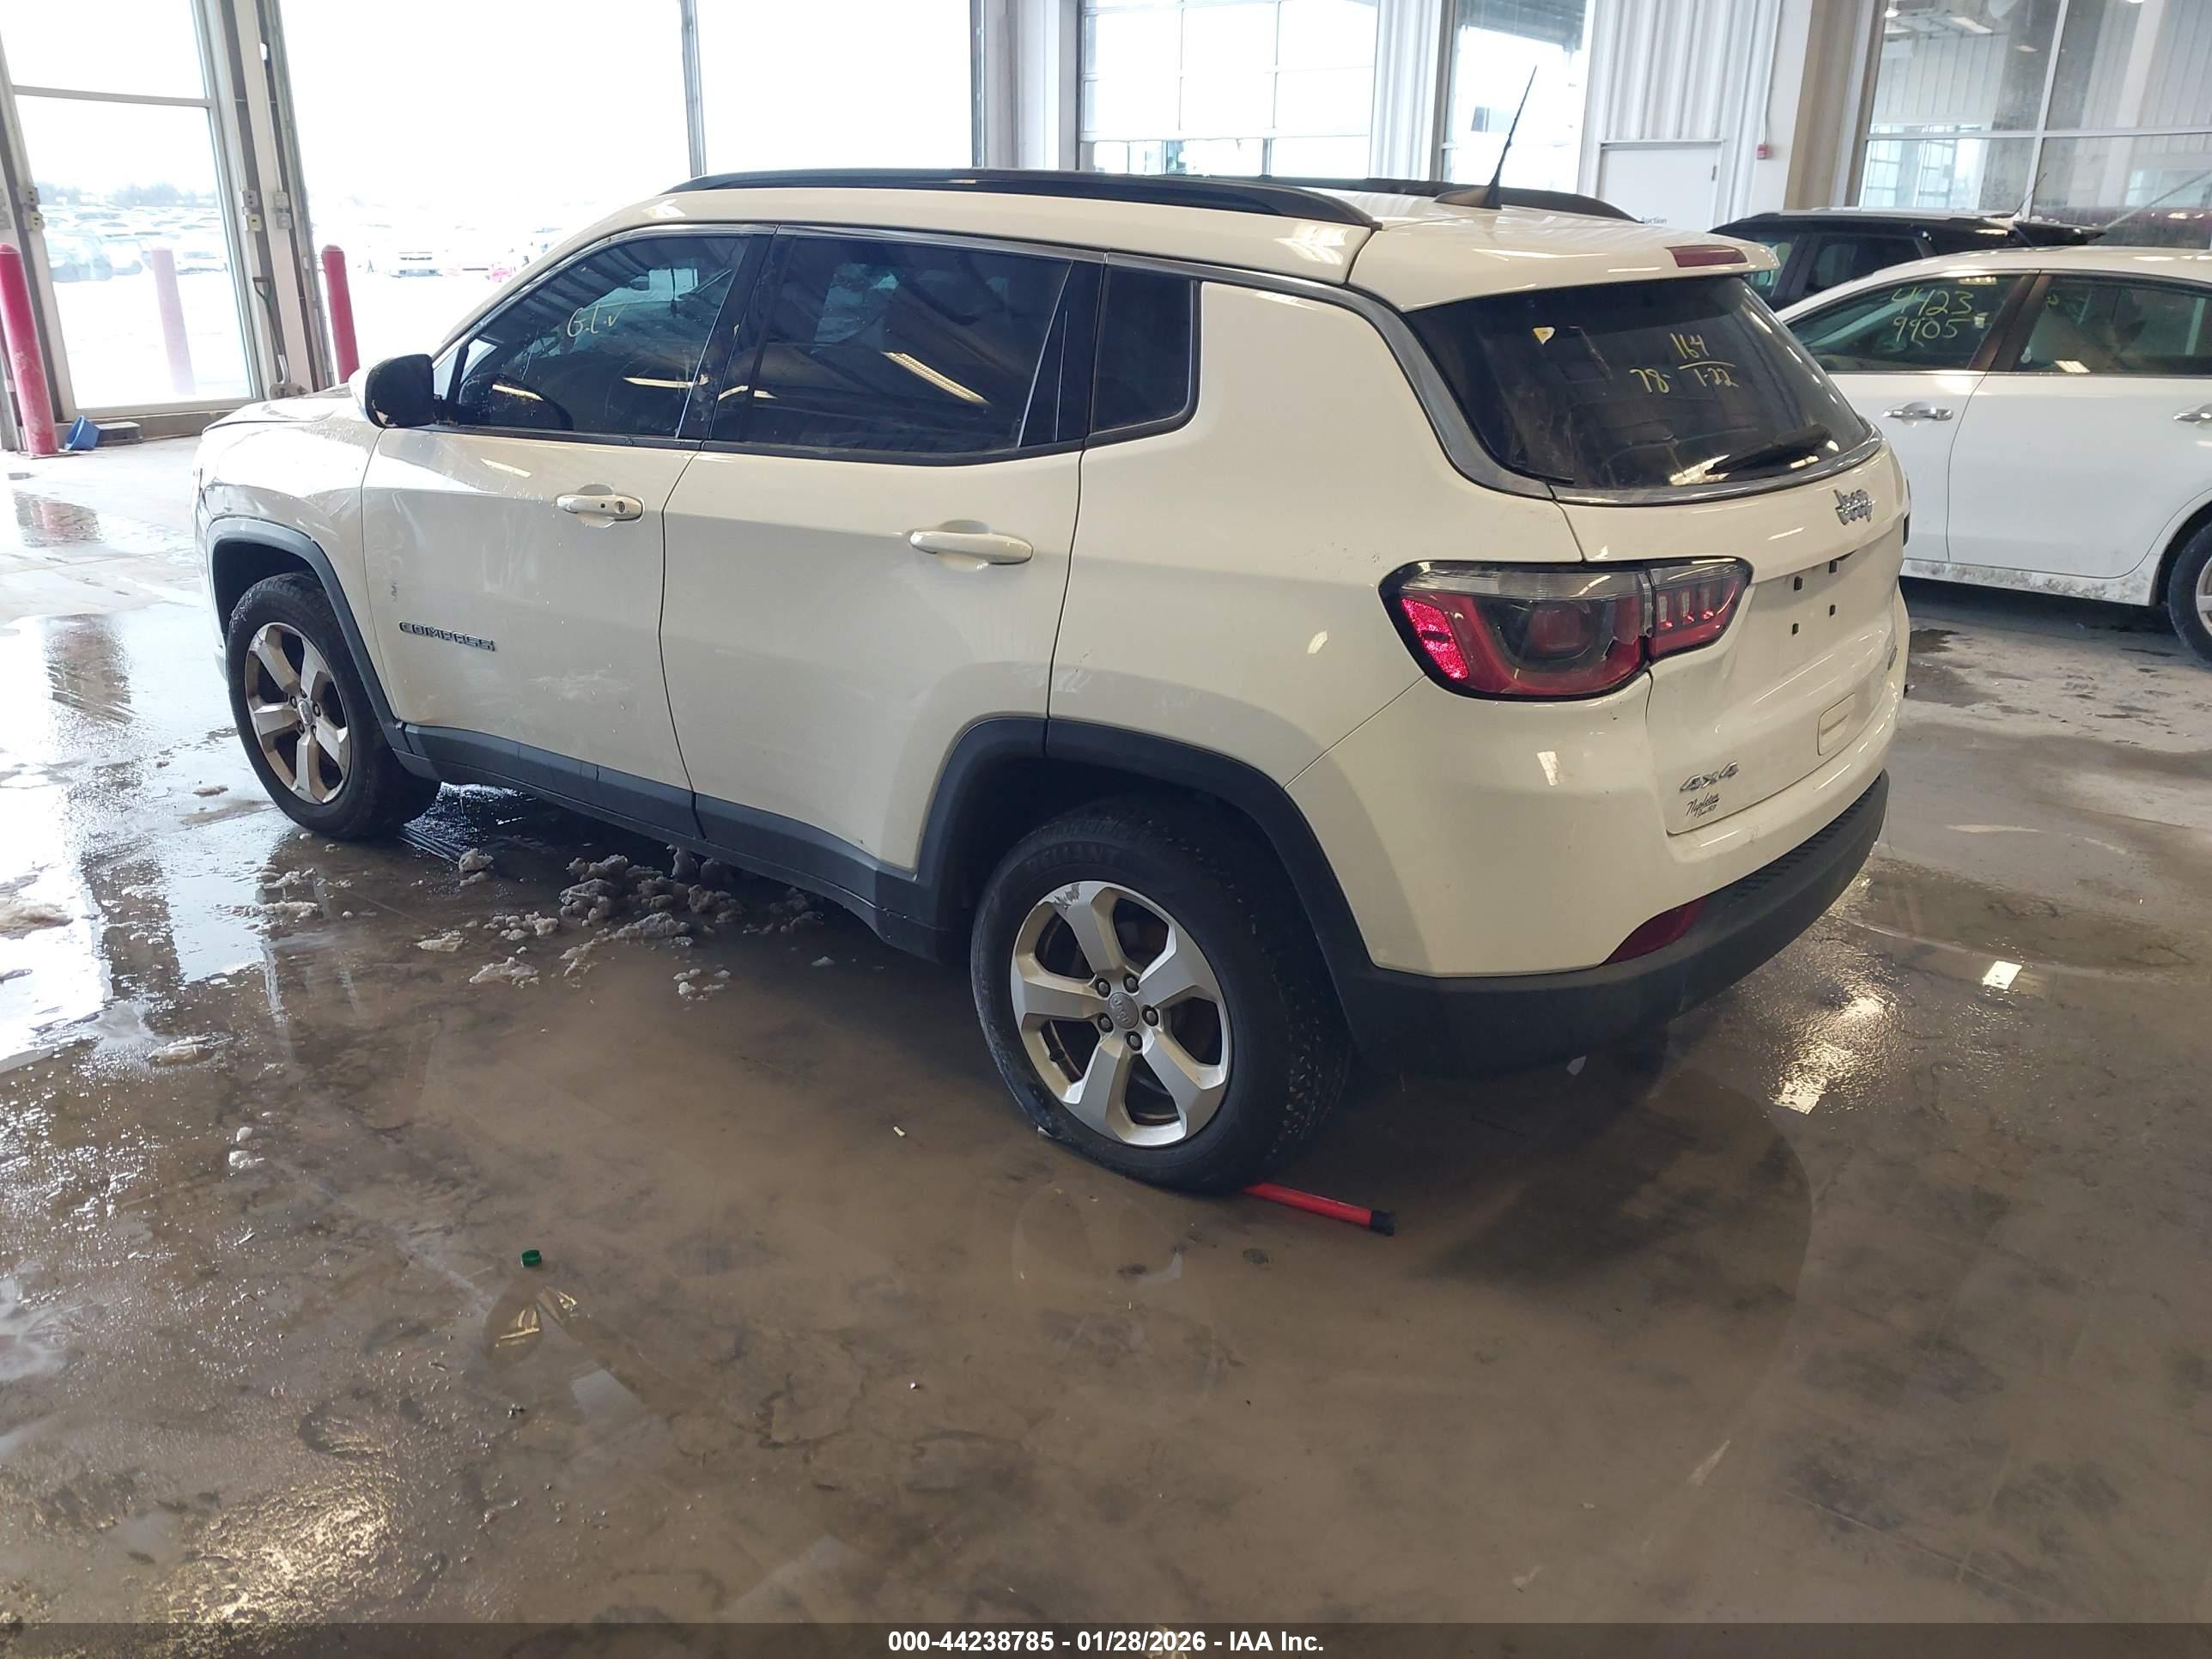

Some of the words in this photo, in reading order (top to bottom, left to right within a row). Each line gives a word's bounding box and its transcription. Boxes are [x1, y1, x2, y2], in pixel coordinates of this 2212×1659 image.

[1669, 332, 1711, 359] 164
[1832, 489, 1875, 526] Jeep
[398, 620, 496, 652] COMPASS
